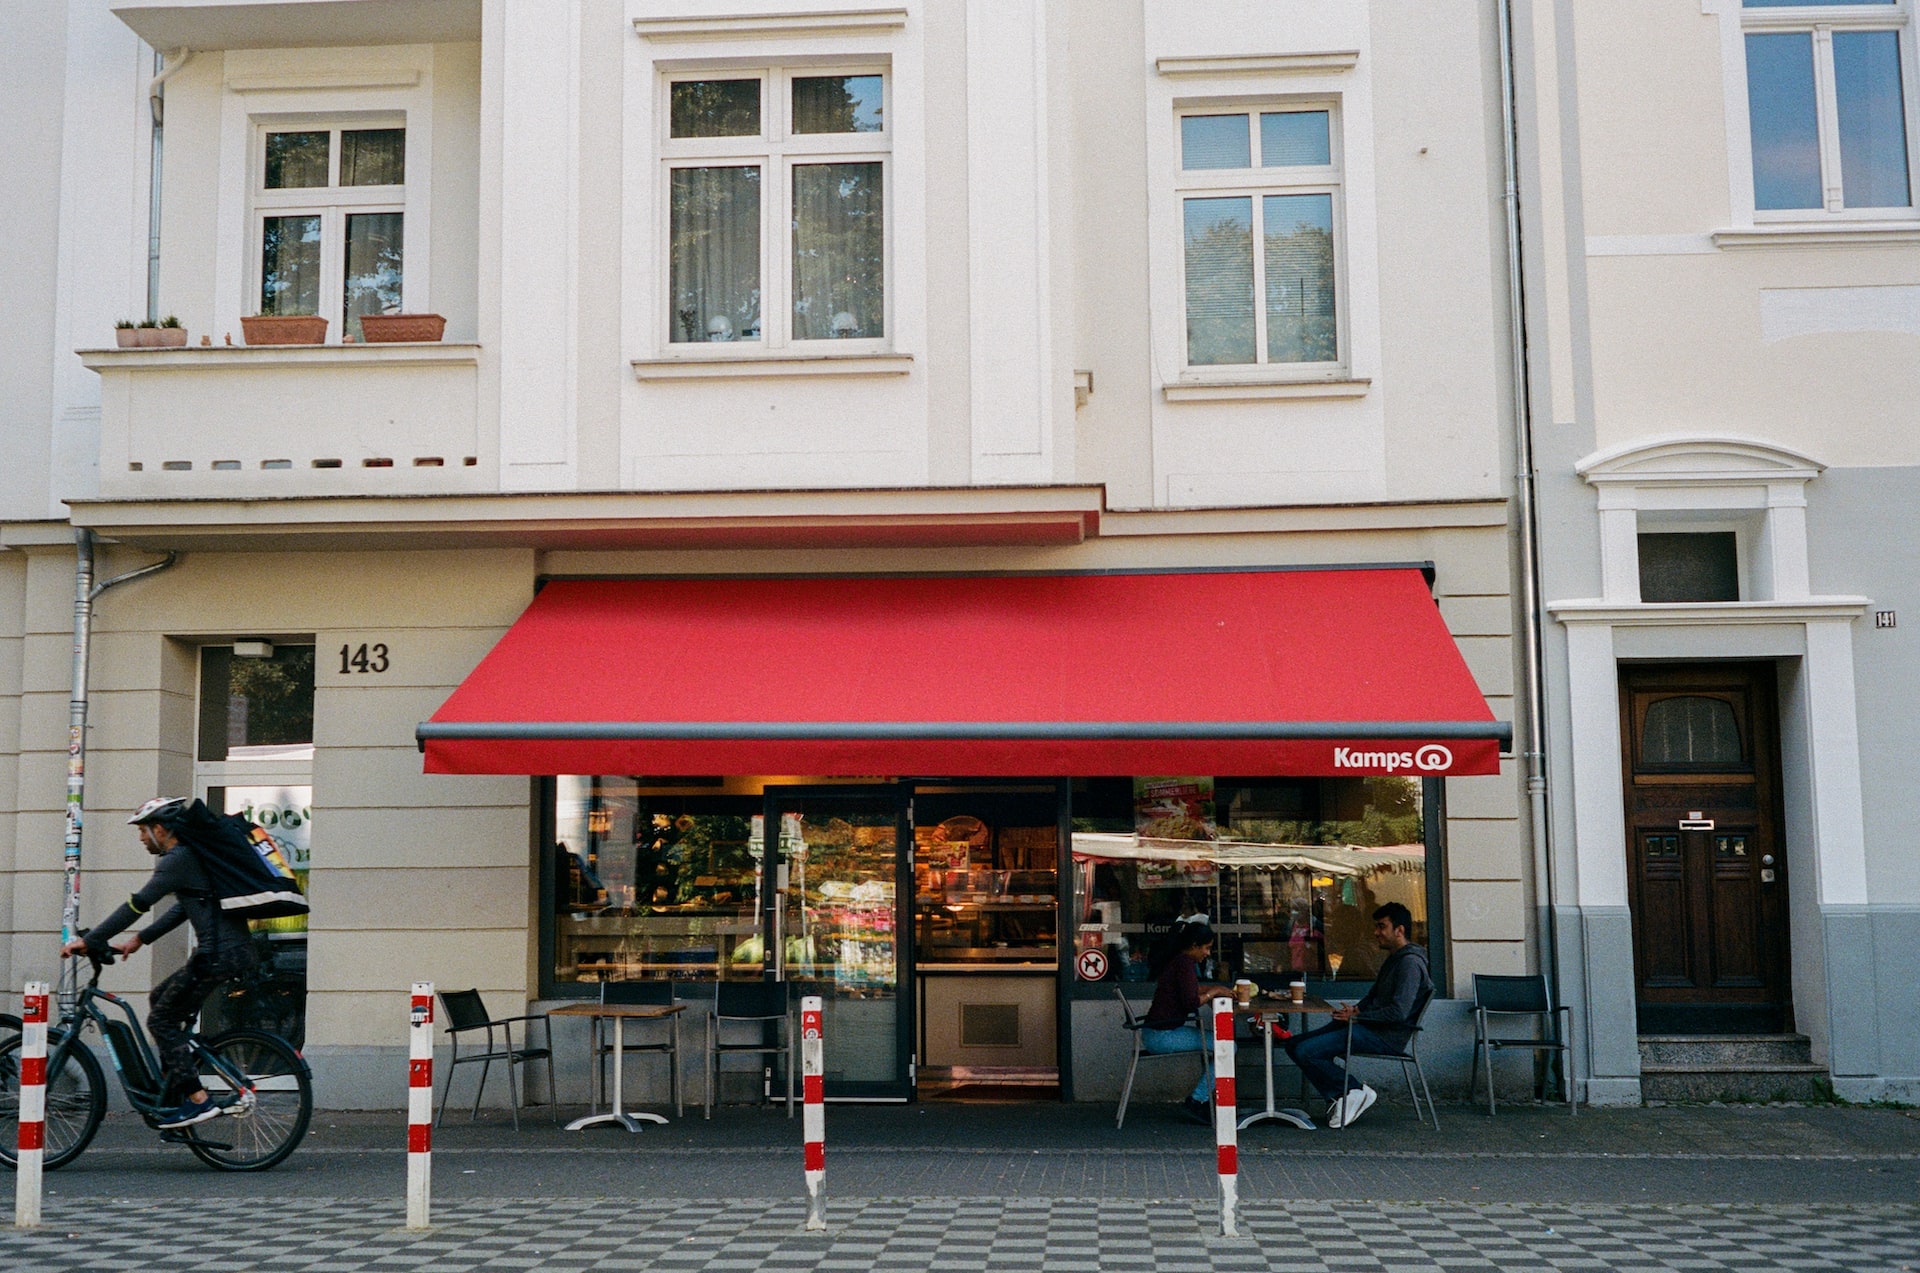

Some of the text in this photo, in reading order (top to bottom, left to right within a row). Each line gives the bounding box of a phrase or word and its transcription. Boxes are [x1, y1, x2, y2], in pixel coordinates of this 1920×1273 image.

[1877, 612, 1895, 627] 141
[339, 643, 389, 674] 143
[1334, 746, 1414, 773] Kamps
